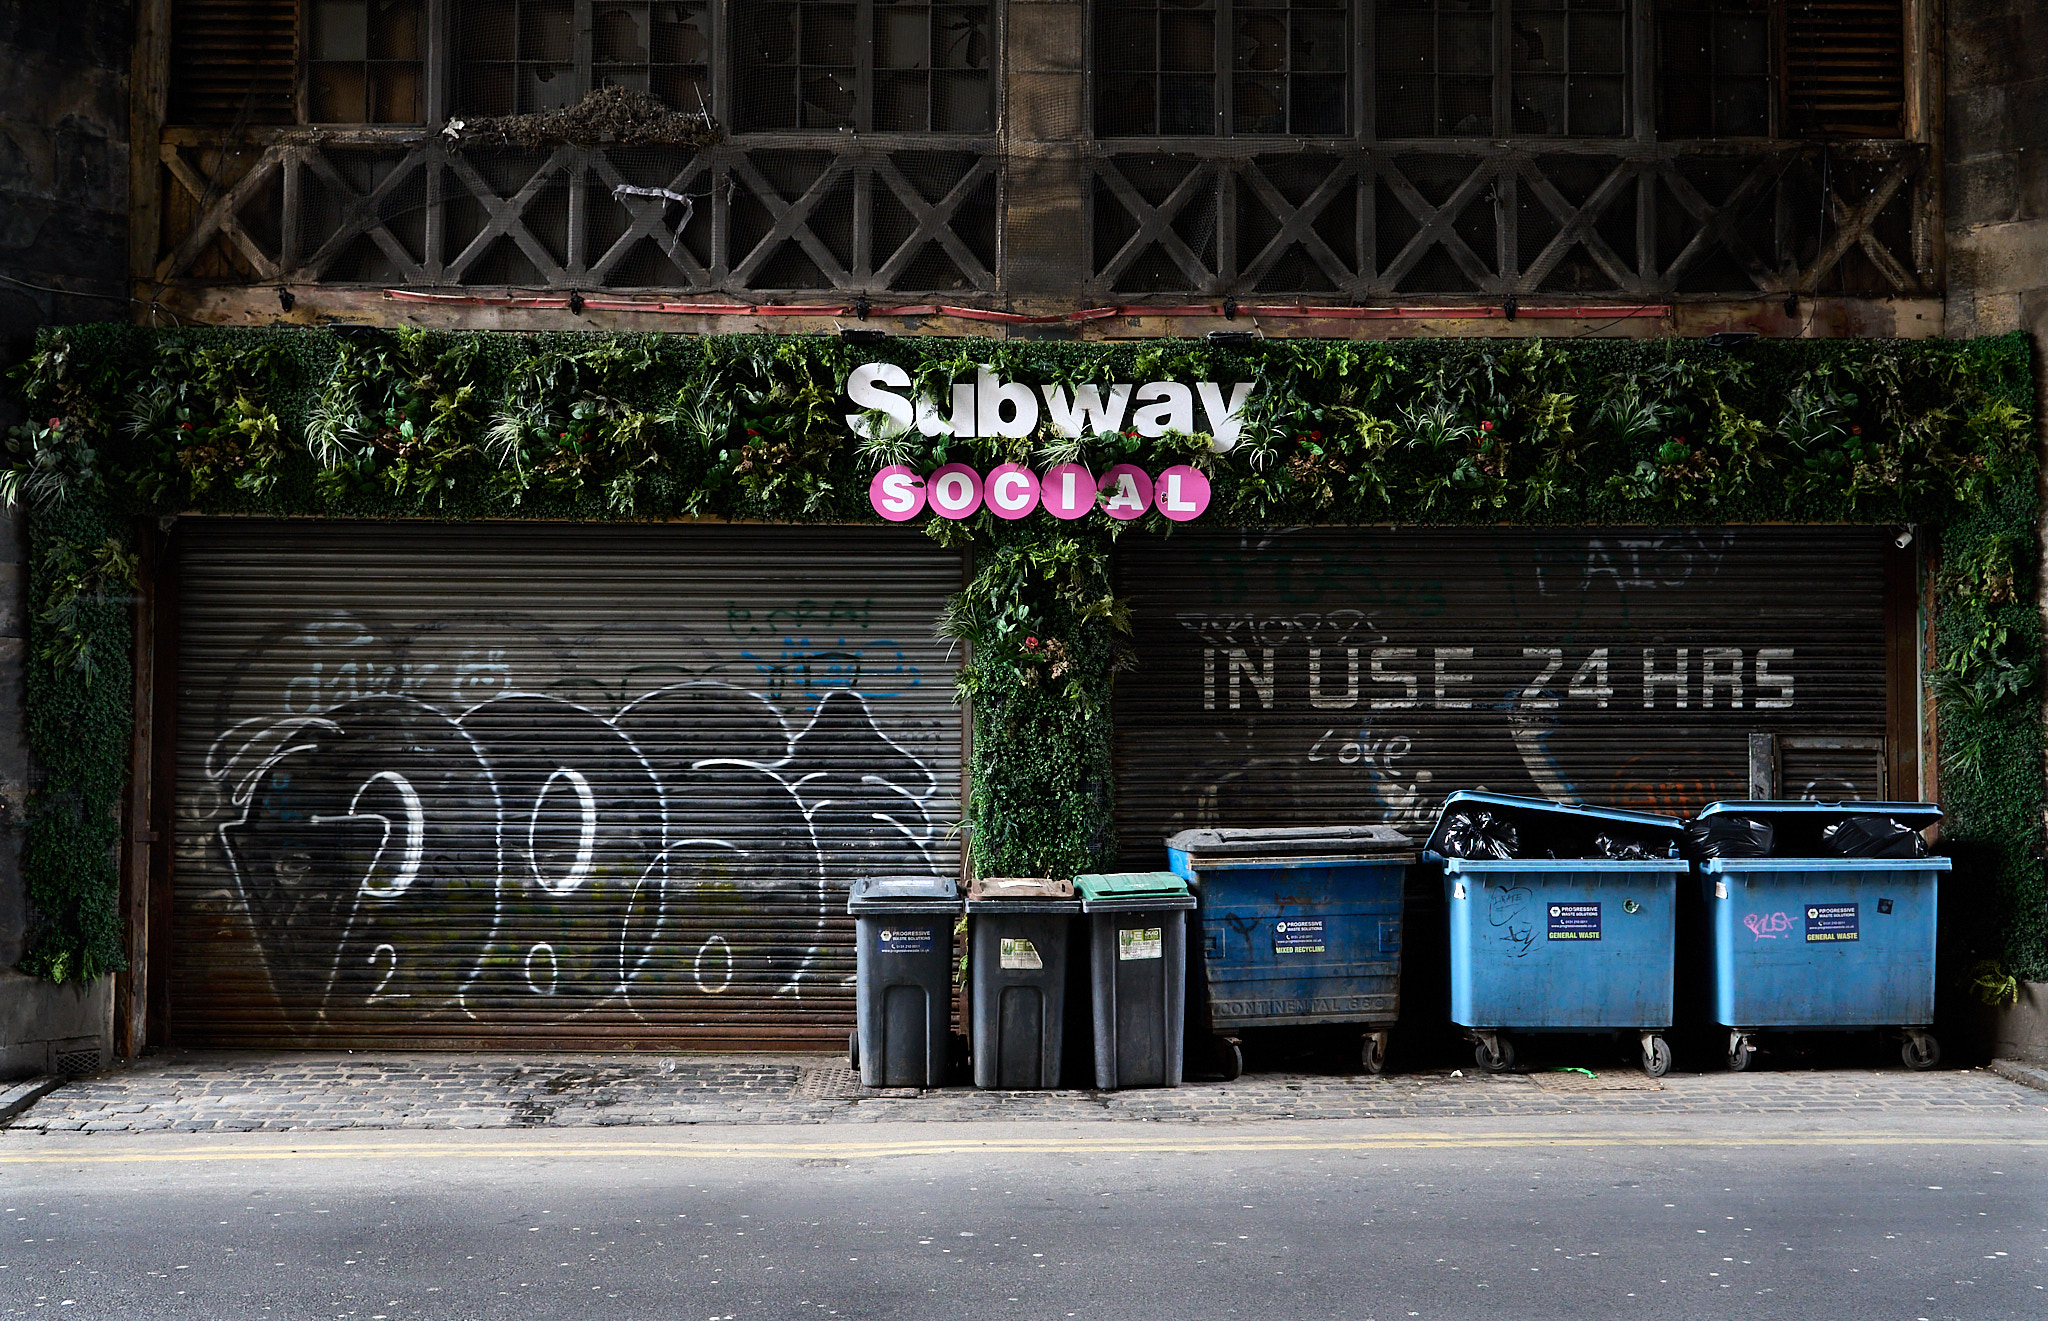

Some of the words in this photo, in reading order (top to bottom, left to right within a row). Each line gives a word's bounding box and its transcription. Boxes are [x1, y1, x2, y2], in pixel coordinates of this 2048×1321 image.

[845, 363, 1256, 453] Subway
[881, 471, 1196, 513] SOCIAL
[1203, 647, 1275, 709] IN
[1309, 647, 1474, 709] USE
[1521, 647, 1614, 709] 24
[1643, 647, 1795, 709] HRS
[1549, 931, 1578, 939] GENERAL
[1578, 931, 1600, 939] WASTE
[1807, 933, 1835, 941] GENERAL
[1836, 932, 1858, 940] WASTE
[1276, 946, 1294, 954] MIXED
[1294, 945, 1325, 953] RECYCLING
[1219, 998, 1341, 1016] CONTINENTAL
